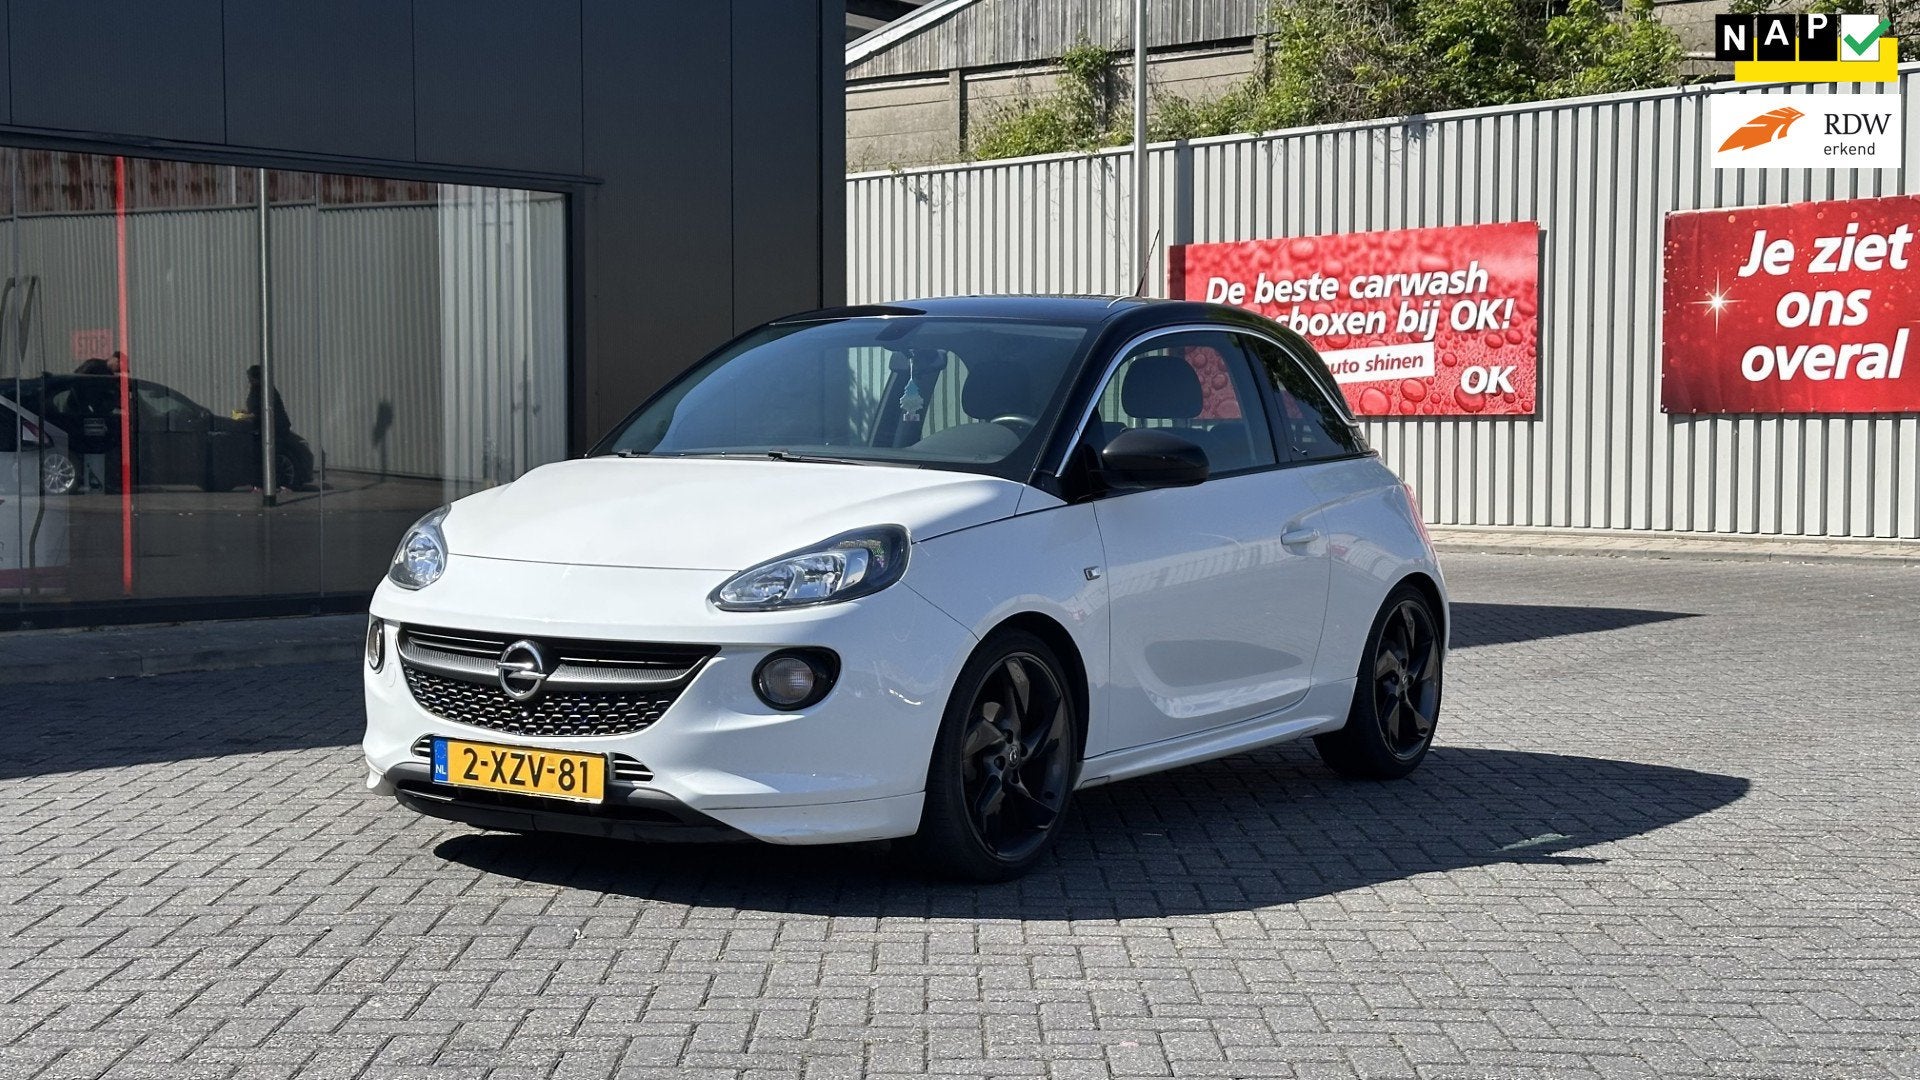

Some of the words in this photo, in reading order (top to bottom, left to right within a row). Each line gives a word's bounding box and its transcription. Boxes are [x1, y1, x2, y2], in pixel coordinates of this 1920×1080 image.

[1738, 229, 1795, 277] Je
[1807, 222, 1914, 273] ziet
[1205, 276, 1246, 305] De
[1253, 271, 1340, 304] beste
[1349, 260, 1489, 299] carwash
[1396, 299, 1442, 341] bij
[1450, 297, 1515, 333] OK!
[1775, 288, 1872, 329] ons
[1325, 358, 1360, 375] uto
[1364, 353, 1424, 373] shinen
[1740, 327, 1910, 382] overal
[1460, 365, 1518, 395] OK
[435, 763, 447, 776] NL
[462, 746, 589, 794] 2-XZV-81
